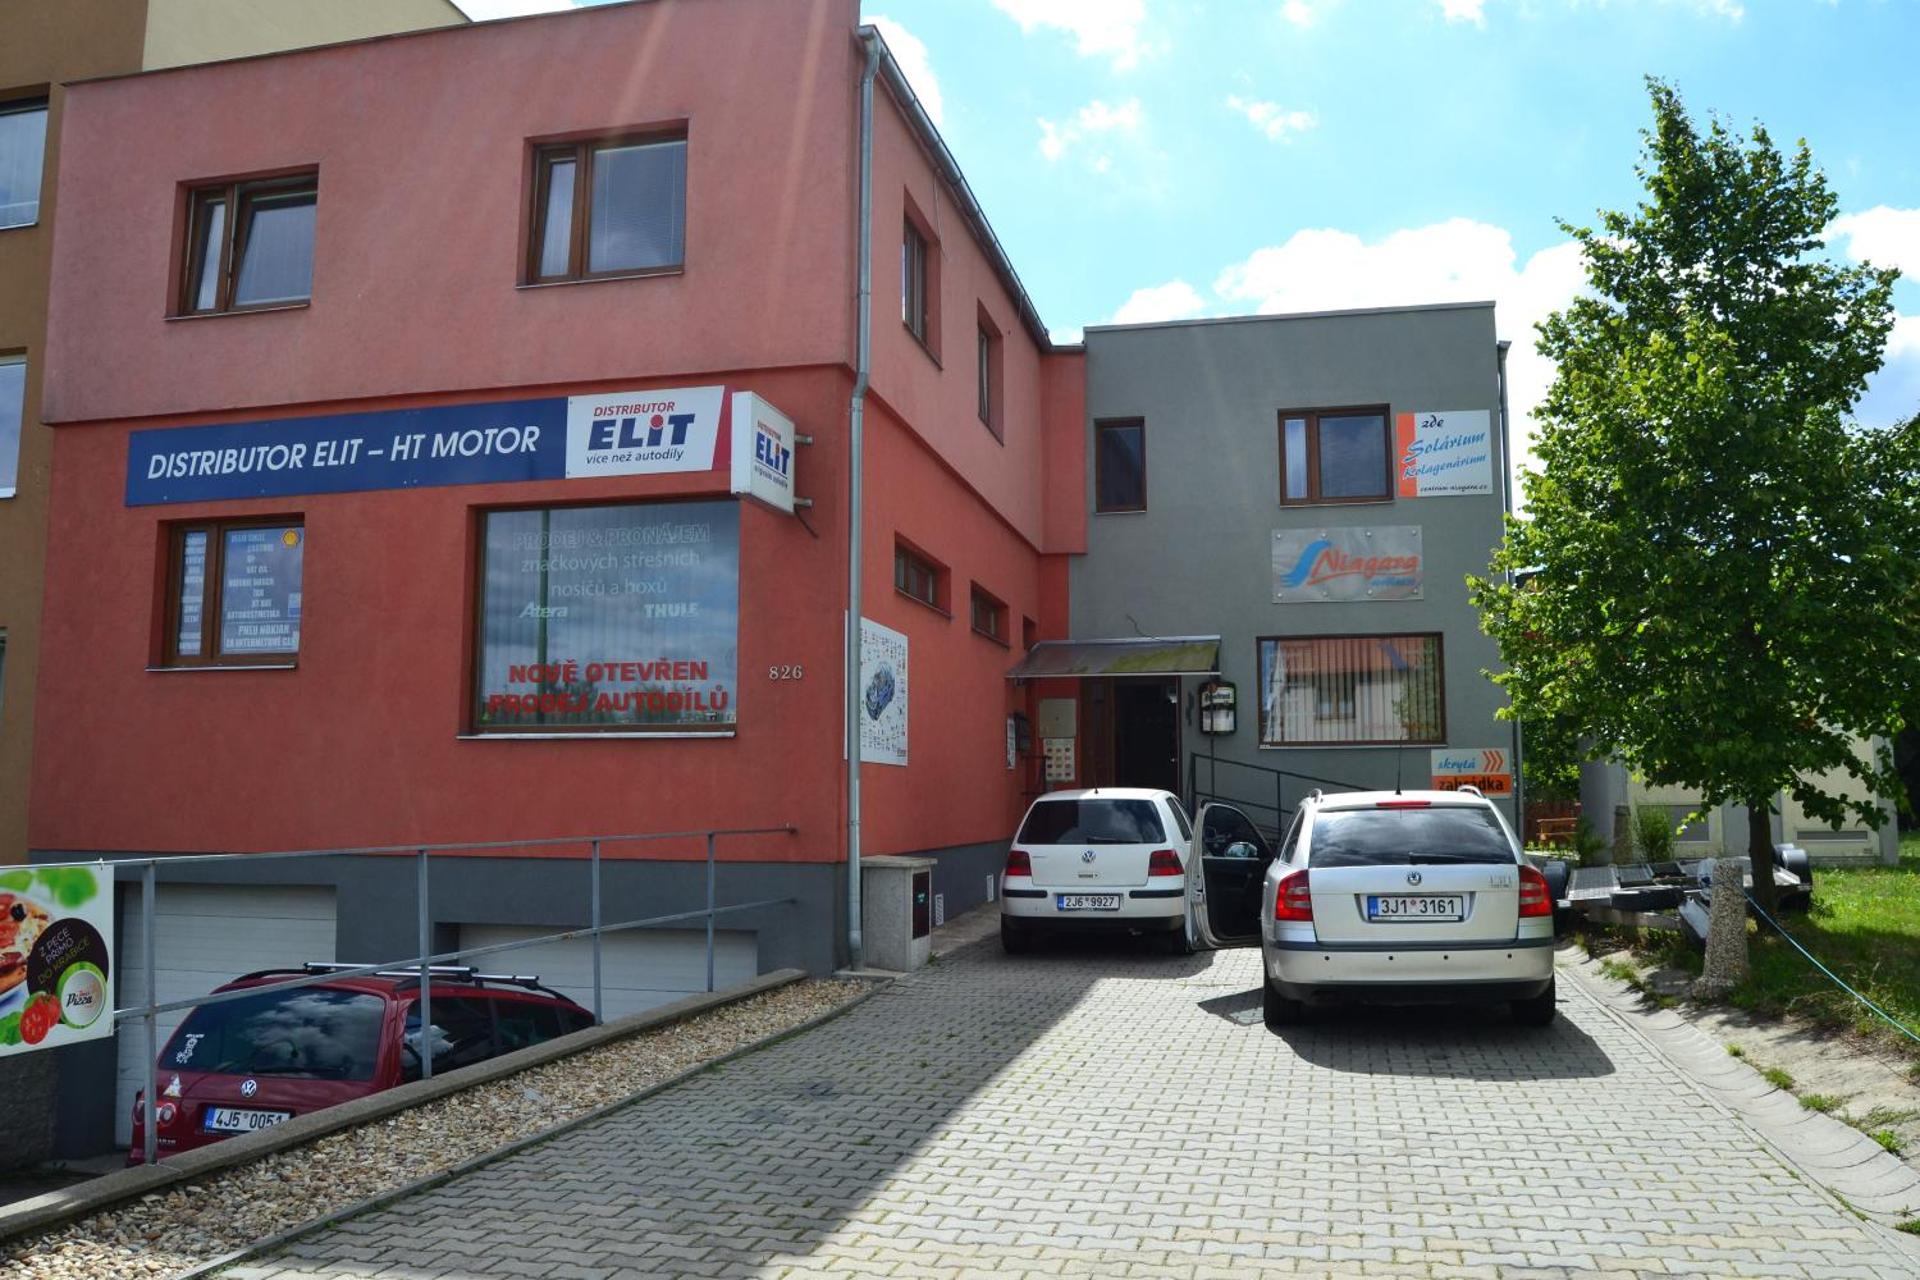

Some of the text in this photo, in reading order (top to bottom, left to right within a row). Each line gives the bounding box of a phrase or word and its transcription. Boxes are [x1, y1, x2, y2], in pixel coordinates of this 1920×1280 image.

[594, 402, 675, 417] DISTRIBUTOR
[1422, 415, 1444, 428] zde
[148, 443, 307, 479] DISTRIBUTOR
[312, 438, 364, 467] ELIT
[390, 433, 426, 462] HT
[430, 425, 540, 458] MOTOR
[612, 449, 632, 463] než
[513, 522, 712, 551] PRODEJ & PRONÁJEM
[520, 553, 618, 574] značkových
[610, 583, 619, 595] a
[519, 601, 699, 619] Atera THULE
[509, 657, 708, 684] NOVĚ OTEVŘEN
[768, 665, 802, 680] 826
[488, 685, 729, 715] PRODEJ AUTODÍLŮ
[1065, 896, 1115, 907] 2J6 9927
[1381, 900, 1455, 914] 3J1 3161
[216, 1110, 241, 1127] 4J5
